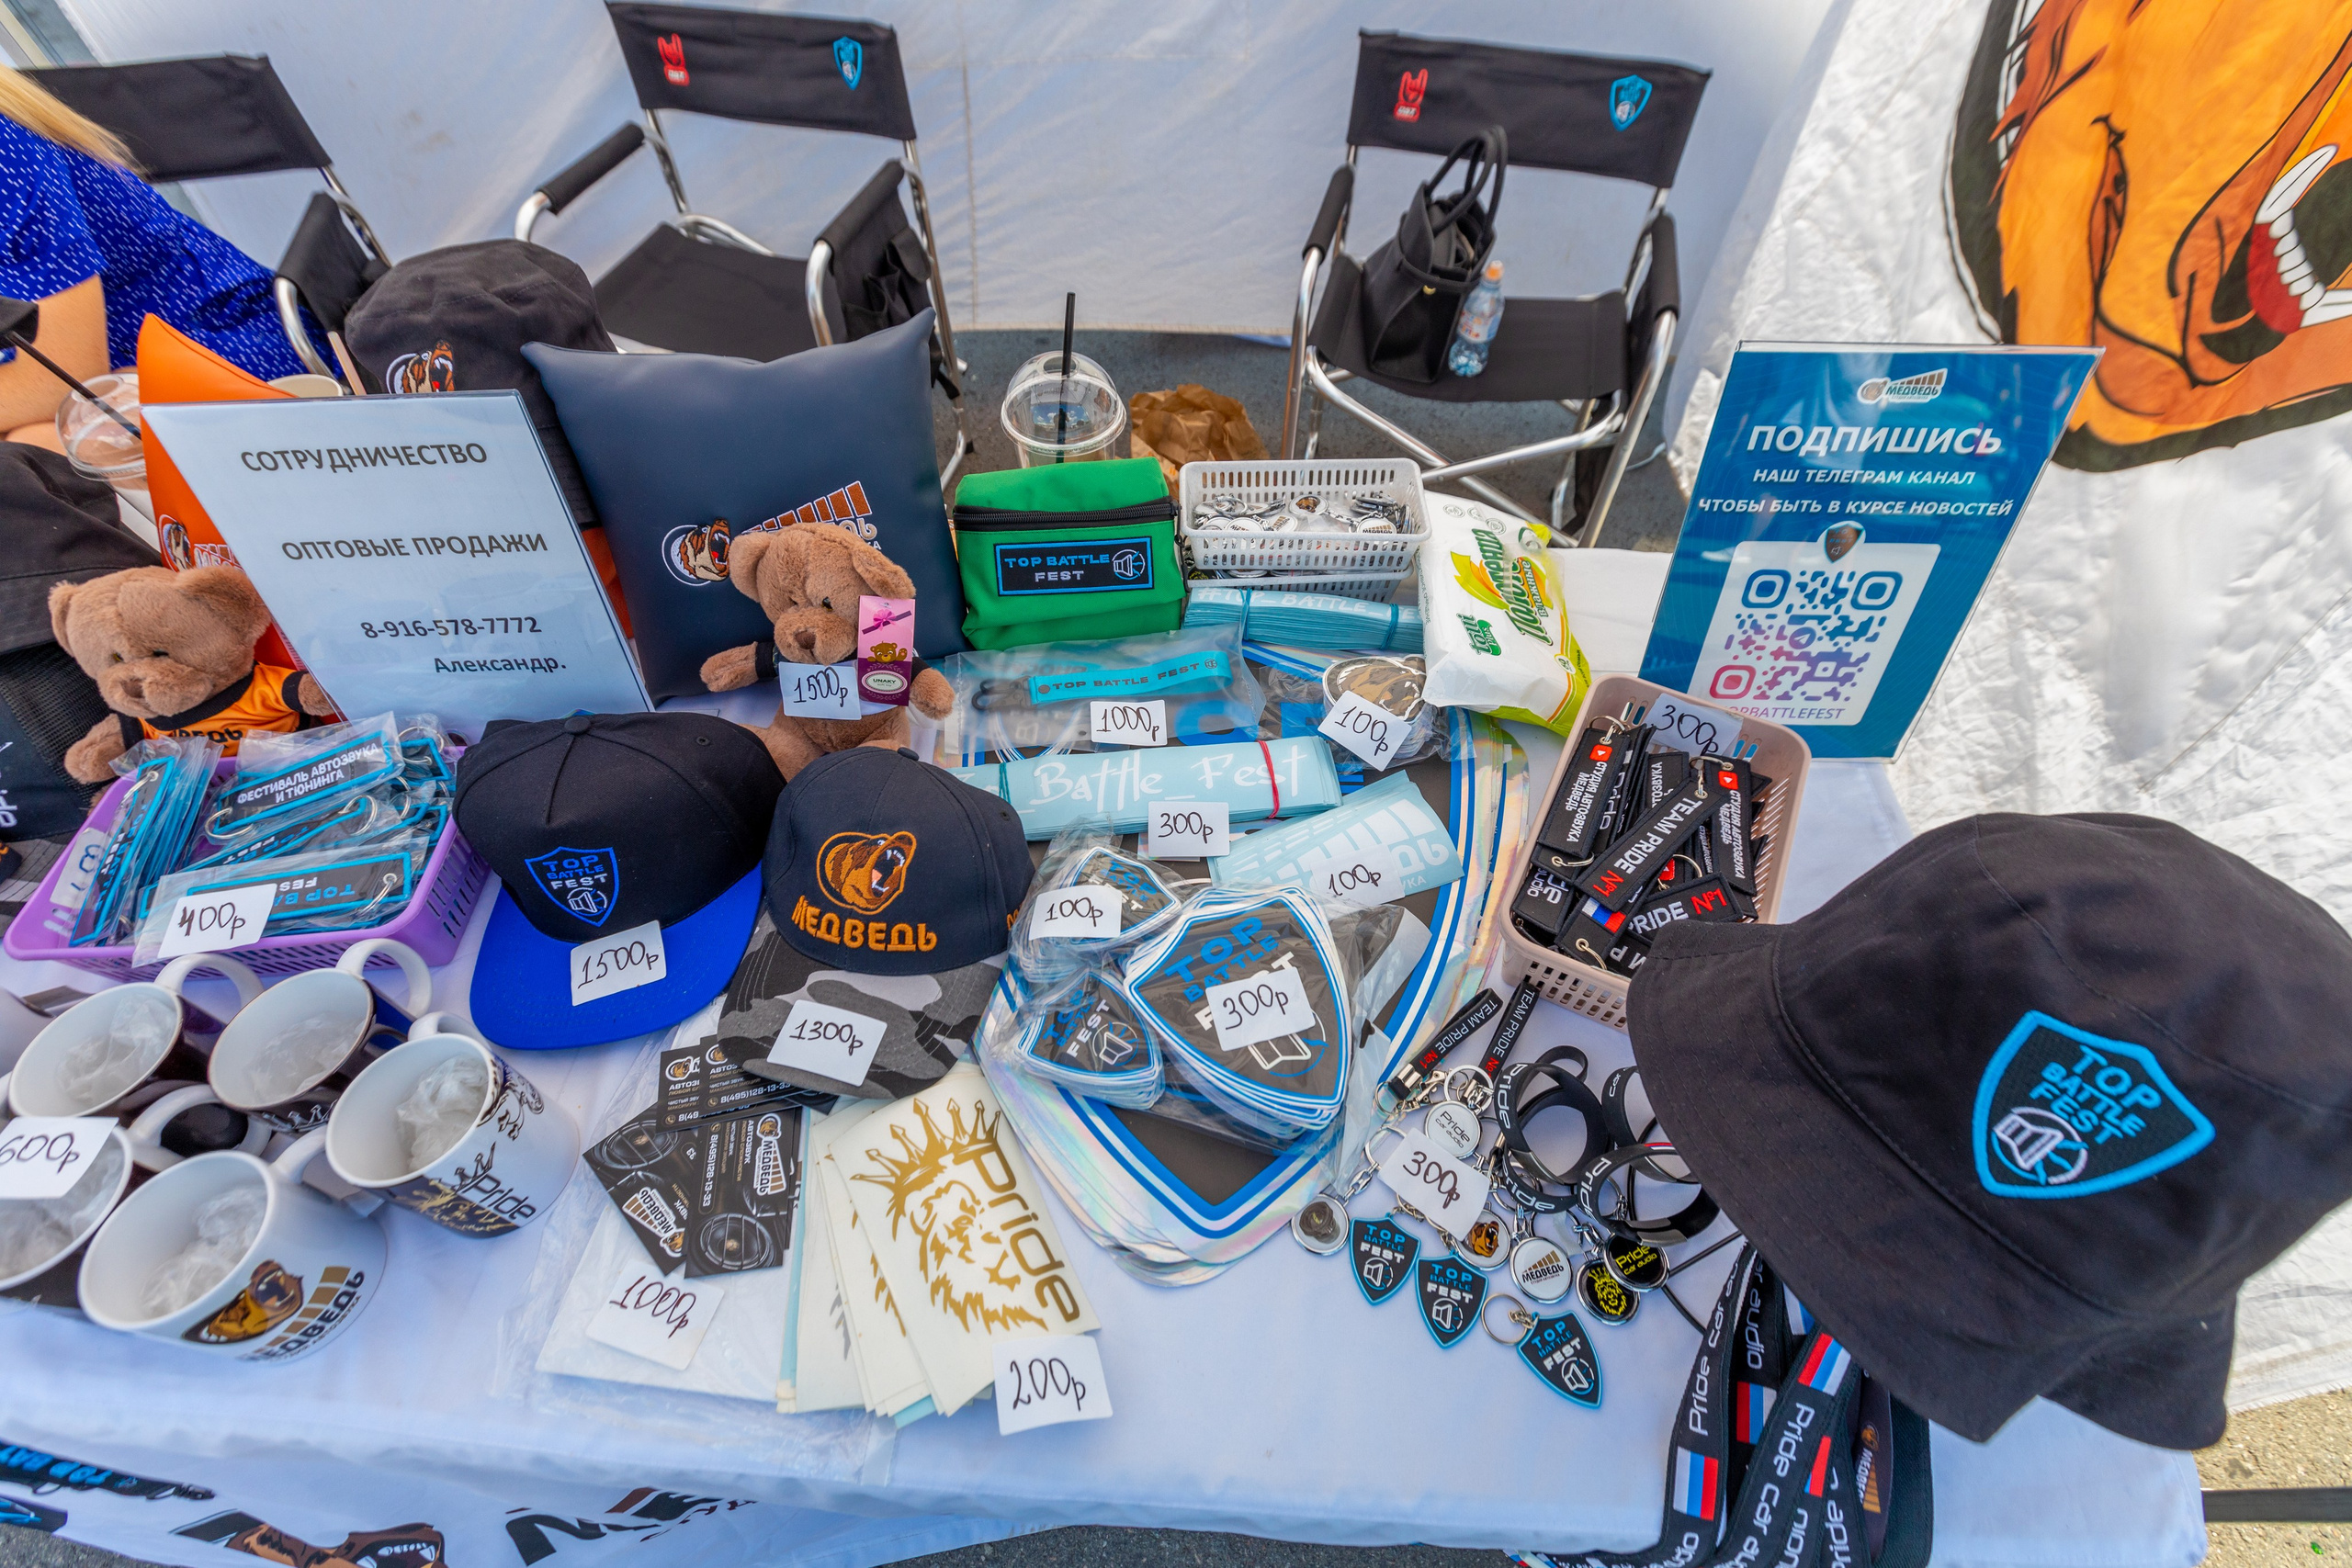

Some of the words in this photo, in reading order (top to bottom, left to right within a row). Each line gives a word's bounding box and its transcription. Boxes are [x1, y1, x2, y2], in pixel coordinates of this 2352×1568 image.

[1885, 386, 1939, 396] МЕДВЕДЬ
[1747, 424, 2002, 457] ПОДПИШИСЬ
[241, 444, 488, 472] СОТРУДНИЧЕСТВО
[1753, 469, 1800, 483] НАШ
[1805, 469, 1902, 485] ТЕЛЕГРАМ
[1906, 470, 1975, 485] КАНАЛ
[1698, 498, 1765, 513] ЧТОБЫ
[1770, 499, 1823, 513] БЫТЬ
[1827, 500, 1841, 513] В
[1845, 501, 1905, 515] КУРСЕ
[1909, 498, 2015, 517] НОВОСТЕЙ
[282, 536, 410, 561] ОПТОВЫЕ
[412, 533, 548, 558] ПРОДАЖИ
[1004, 556, 1043, 569] TOP
[1046, 554, 1110, 567] BATTLE
[1035, 570, 1084, 582] FEST
[362, 616, 542, 640] 8-916-578-7772
[434, 655, 567, 675] Александр.
[1053, 681, 1087, 690] TOP
[1093, 676, 1149, 686] BATTLE
[1158, 663, 1200, 681] FEST
[793, 666, 849, 708] 1500р
[1096, 706, 1160, 742] 1000р
[1334, 706, 1388, 757] 100р
[1654, 704, 1718, 755] 300р
[237, 770, 310, 805] ФЕСТИВАЛЬ
[311, 742, 379, 779] АВТОЗВУКА
[276, 790, 285, 804] И
[285, 769, 345, 799] ТЮНИНГА
[1586, 761, 1608, 793] СТУДИЯ
[1566, 772, 1586, 812] МЕДВЕДЬ
[1729, 790, 1742, 824] СТУДИЯ
[1158, 811, 1215, 843] 300р
[1566, 790, 1595, 843] АВТОЗВУКА
[1654, 797, 1703, 835] TEAM
[542, 854, 599, 872] TOP
[1613, 832, 1664, 874] PRIDE
[1731, 822, 1746, 879] АВТОЗВУКА
[279, 877, 318, 892] FES
[547, 864, 605, 880] BATTLE
[550, 874, 608, 890] FEST
[1100, 869, 1149, 903] BATTLE
[1110, 861, 1158, 896] TOP
[1329, 864, 1382, 897] 100р
[305, 885, 356, 902] TOP
[178, 902, 246, 941] 400р
[791, 895, 938, 953] МЕДВЕДЬ
[1045, 897, 1103, 927] 100р
[579, 944, 660, 989] 1500р
[1164, 917, 1263, 983] TOP
[1183, 935, 1279, 1004] BATTLE
[1043, 989, 1084, 1040] TOP
[1223, 984, 1289, 1030] 300р
[1468, 999, 1498, 1028] TEAM
[1515, 988, 1535, 1021] TEAM
[790, 1018, 864, 1051] 1300р
[1057, 997, 1097, 1047] BATTLE
[1067, 999, 1110, 1058] FEST
[1434, 1022, 1470, 1055] PRIDE
[1492, 1018, 1520, 1058] PRIDE
[1610, 1073, 1621, 1097] car
[2071, 1044, 2163, 1110] TOP
[1498, 1064, 1529, 1131] Pride
[2029, 1082, 2125, 1145] FEST
[2041, 1062, 2148, 1138] BATTLE
[743, 1120, 754, 1164] АВТОЗВУК
[1440, 1111, 1470, 1144] Pride
[1445, 1128, 1464, 1149] audio
[702, 1134, 719, 1207] 8(495)128-13-33
[759, 1140, 774, 1195] МЕДВЕДЬ
[1403, 1150, 1461, 1210] 300р
[461, 1173, 537, 1220] Pride
[639, 1189, 673, 1234] МЕДВЕДЬ
[954, 1146, 1081, 1323] Pride
[1364, 1234, 1405, 1252] BATTLE
[1366, 1224, 1406, 1244] TOP
[1360, 1241, 1405, 1264] FEST
[1615, 1245, 1651, 1269] Pride
[1430, 1274, 1472, 1292] BATTLE
[1431, 1264, 1473, 1282] TOP
[1521, 1264, 1565, 1283] МЕДВЕДЬ
[609, 1274, 696, 1340] 1000р
[1427, 1282, 1473, 1303] FEST
[1532, 1321, 1566, 1348] TOP
[1538, 1330, 1573, 1359] BATTLE
[1745, 1288, 1765, 1371] audio
[1543, 1337, 1582, 1371] FEST
[1688, 1356, 1711, 1436] Pride
[1707, 1301, 1724, 1348] car
[1010, 1357, 1087, 1412] 200р
[1773, 1402, 1816, 1479] Pride
[1752, 1483, 1782, 1538] car
